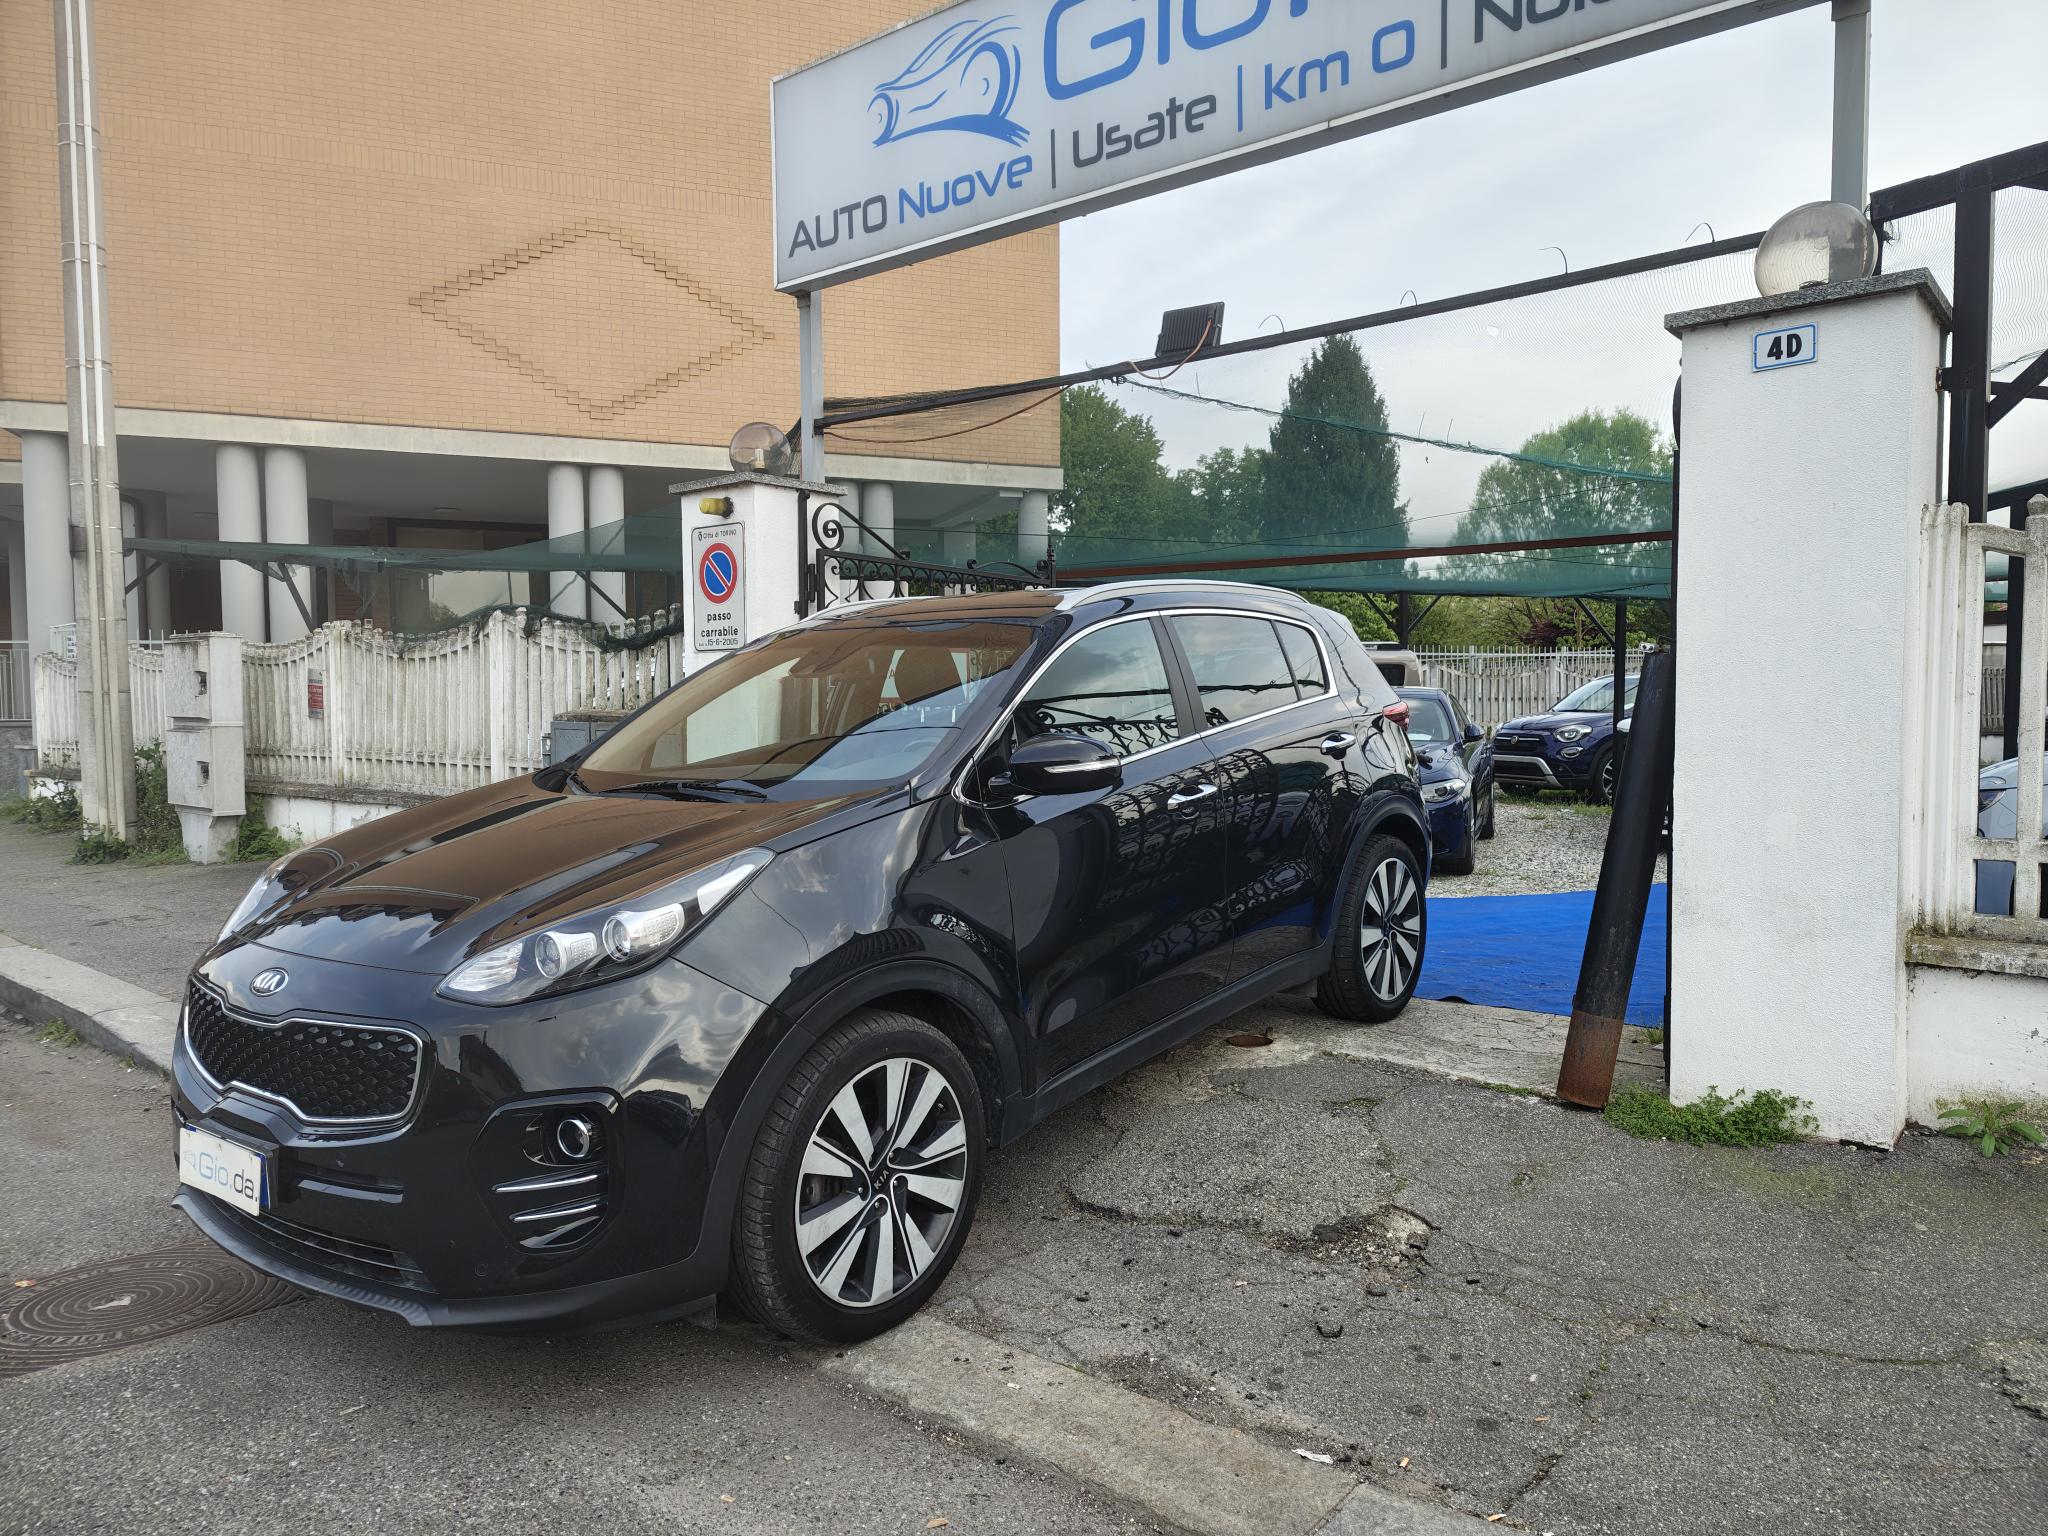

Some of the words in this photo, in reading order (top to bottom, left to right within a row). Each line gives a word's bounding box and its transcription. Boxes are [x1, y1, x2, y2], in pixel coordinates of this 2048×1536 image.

[788, 194, 888, 258] AUTO
[899, 154, 1033, 224] Nuove
[1072, 94, 1217, 169] Usate
[1264, 50, 1350, 110] km
[1767, 333, 1803, 360] 4D
[707, 612, 732, 623] passo
[701, 626, 739, 638] carrabile
[253, 972, 281, 991] KIA
[874, 1169, 889, 1190] KIA
